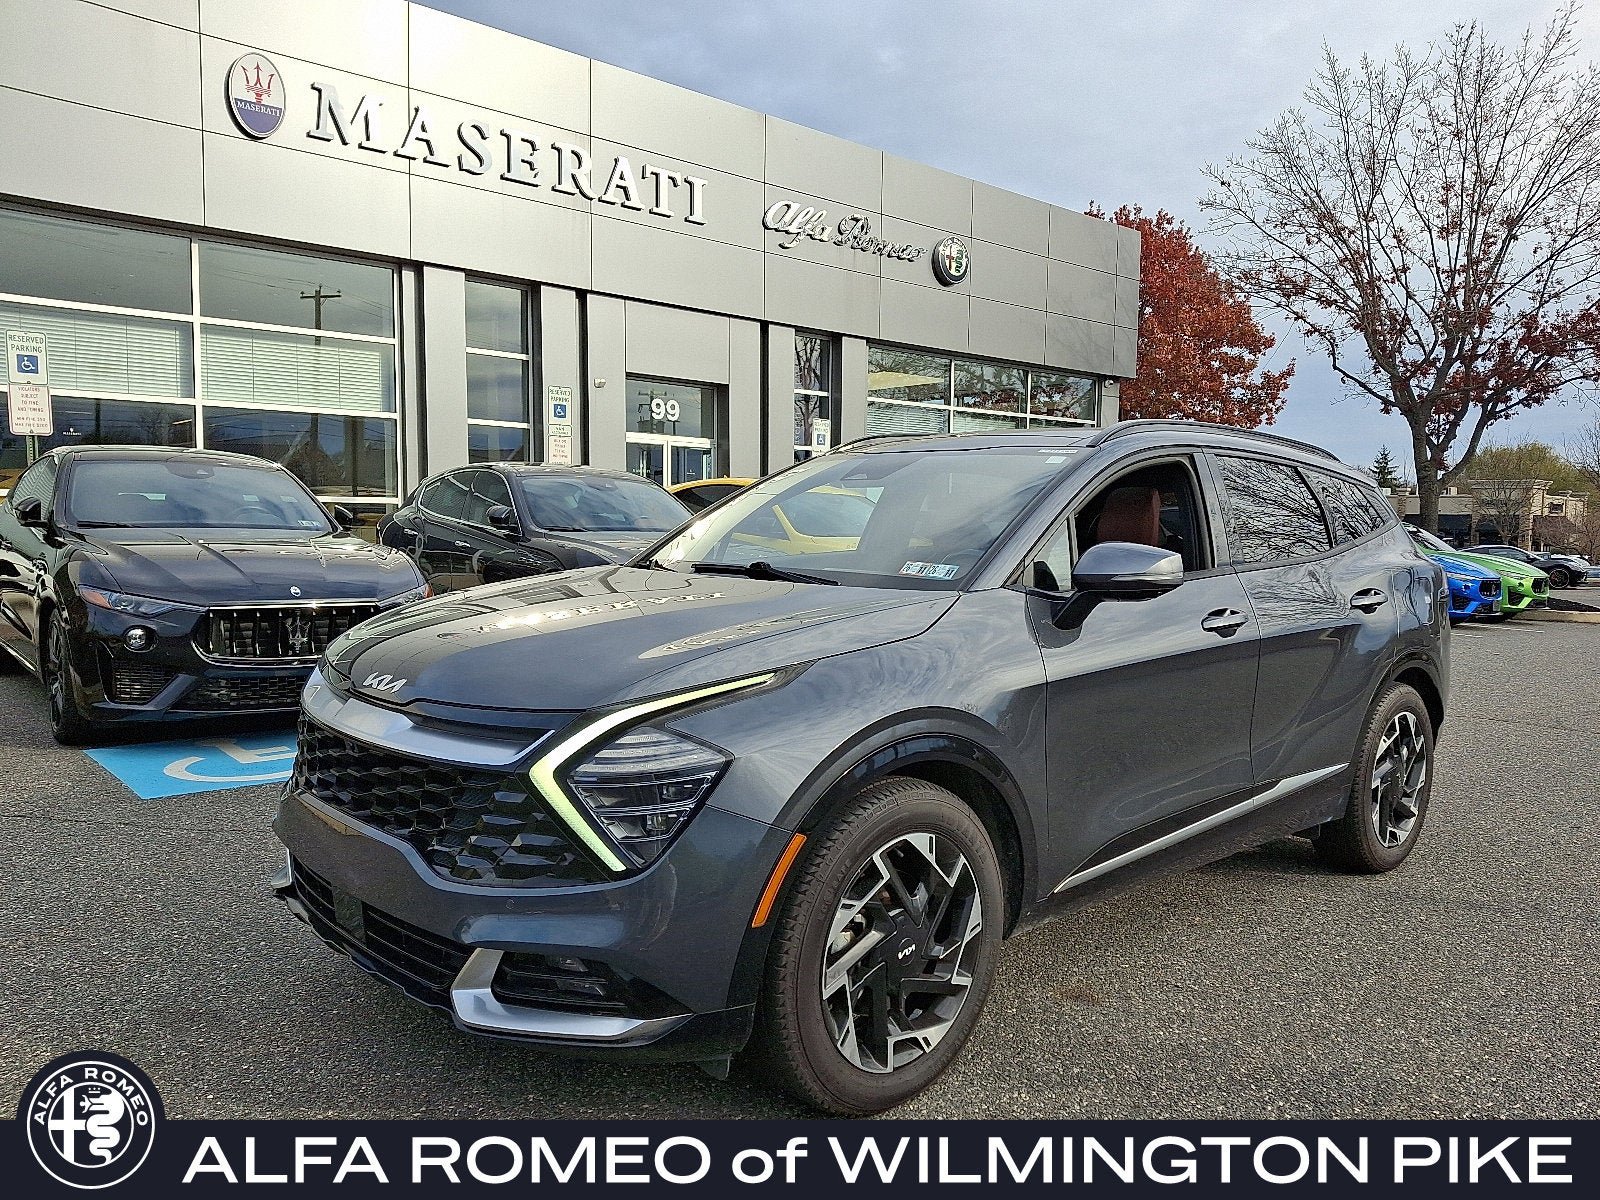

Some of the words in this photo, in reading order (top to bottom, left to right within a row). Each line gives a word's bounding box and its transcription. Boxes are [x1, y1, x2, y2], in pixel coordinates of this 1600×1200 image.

[236, 101, 280, 117] MASERATI
[306, 82, 708, 225] MASERATI
[762, 200, 833, 249] Alfa
[833, 213, 928, 262] Romeo
[8, 334, 44, 345] RESERVED
[11, 344, 42, 353] PARKING
[651, 398, 680, 421] 99
[362, 671, 408, 694] KIA
